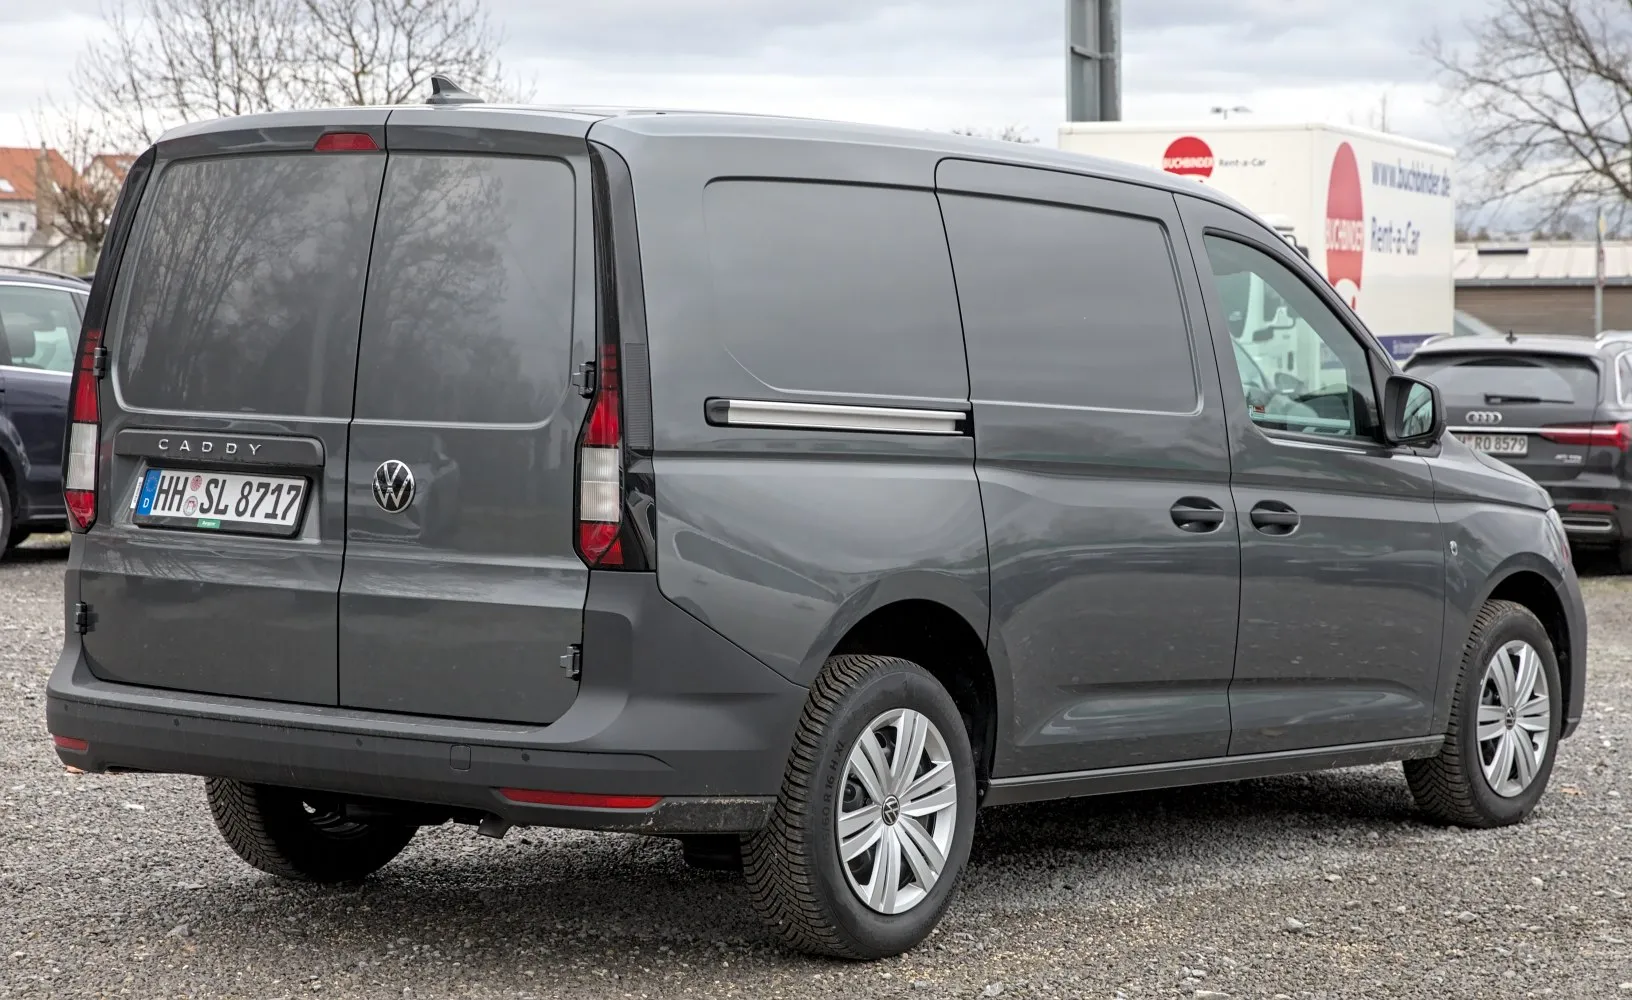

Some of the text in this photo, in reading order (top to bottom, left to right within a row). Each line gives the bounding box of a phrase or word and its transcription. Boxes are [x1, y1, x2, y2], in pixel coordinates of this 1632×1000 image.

[1219, 158, 1267, 167] Rent-a-Car
[1371, 157, 1451, 198] www.buchbinder.de
[1371, 216, 1420, 255] Rent-a-Car
[157, 438, 262, 455] CADDY
[1494, 436, 1526, 451] 8579
[142, 497, 150, 508] D
[153, 475, 189, 512] HH
[199, 477, 229, 516] SL
[234, 480, 303, 521] 8717
